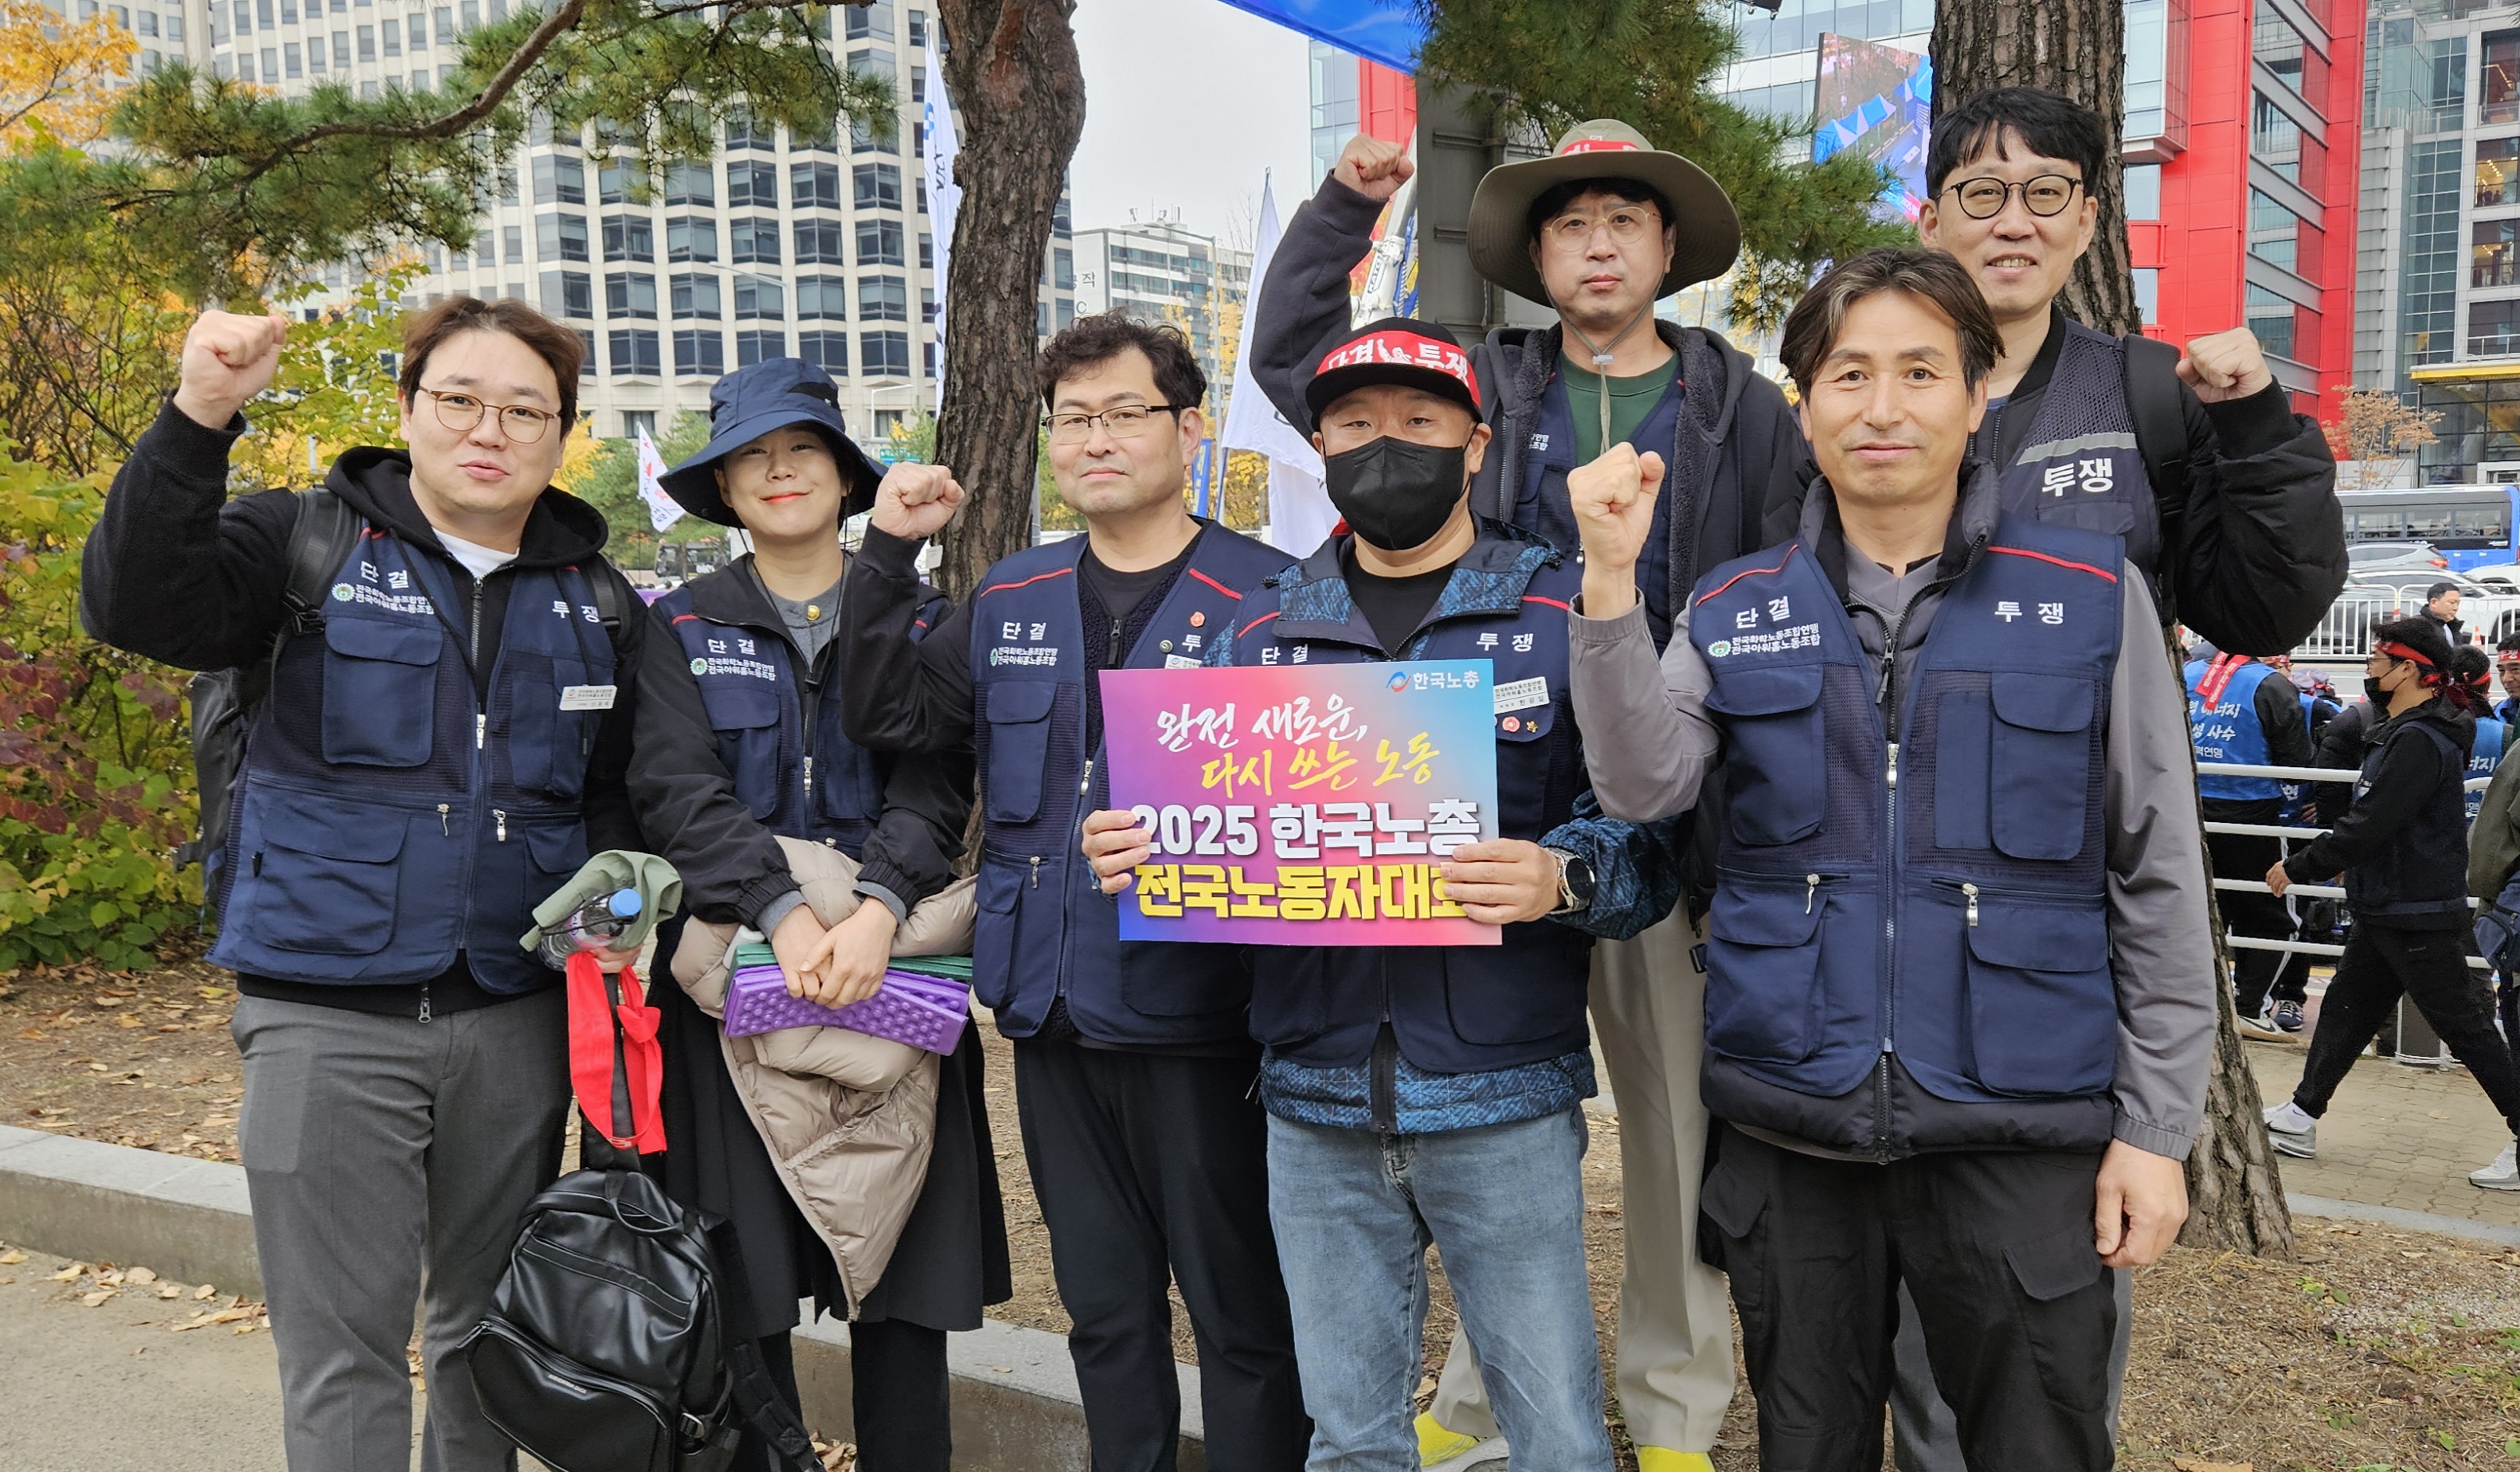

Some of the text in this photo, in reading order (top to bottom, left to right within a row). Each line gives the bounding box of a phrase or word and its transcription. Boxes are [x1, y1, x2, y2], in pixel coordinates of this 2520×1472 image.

[2041, 457, 2114, 497] 투쟁
[1413, 670, 1480, 690] 한국노총
[1156, 693, 1368, 753] 완전 새로운,
[2207, 724, 2236, 742] 사수
[1201, 731, 1440, 799] 다시 쓰는 노동
[1133, 798, 1481, 859] 2025 한국노총
